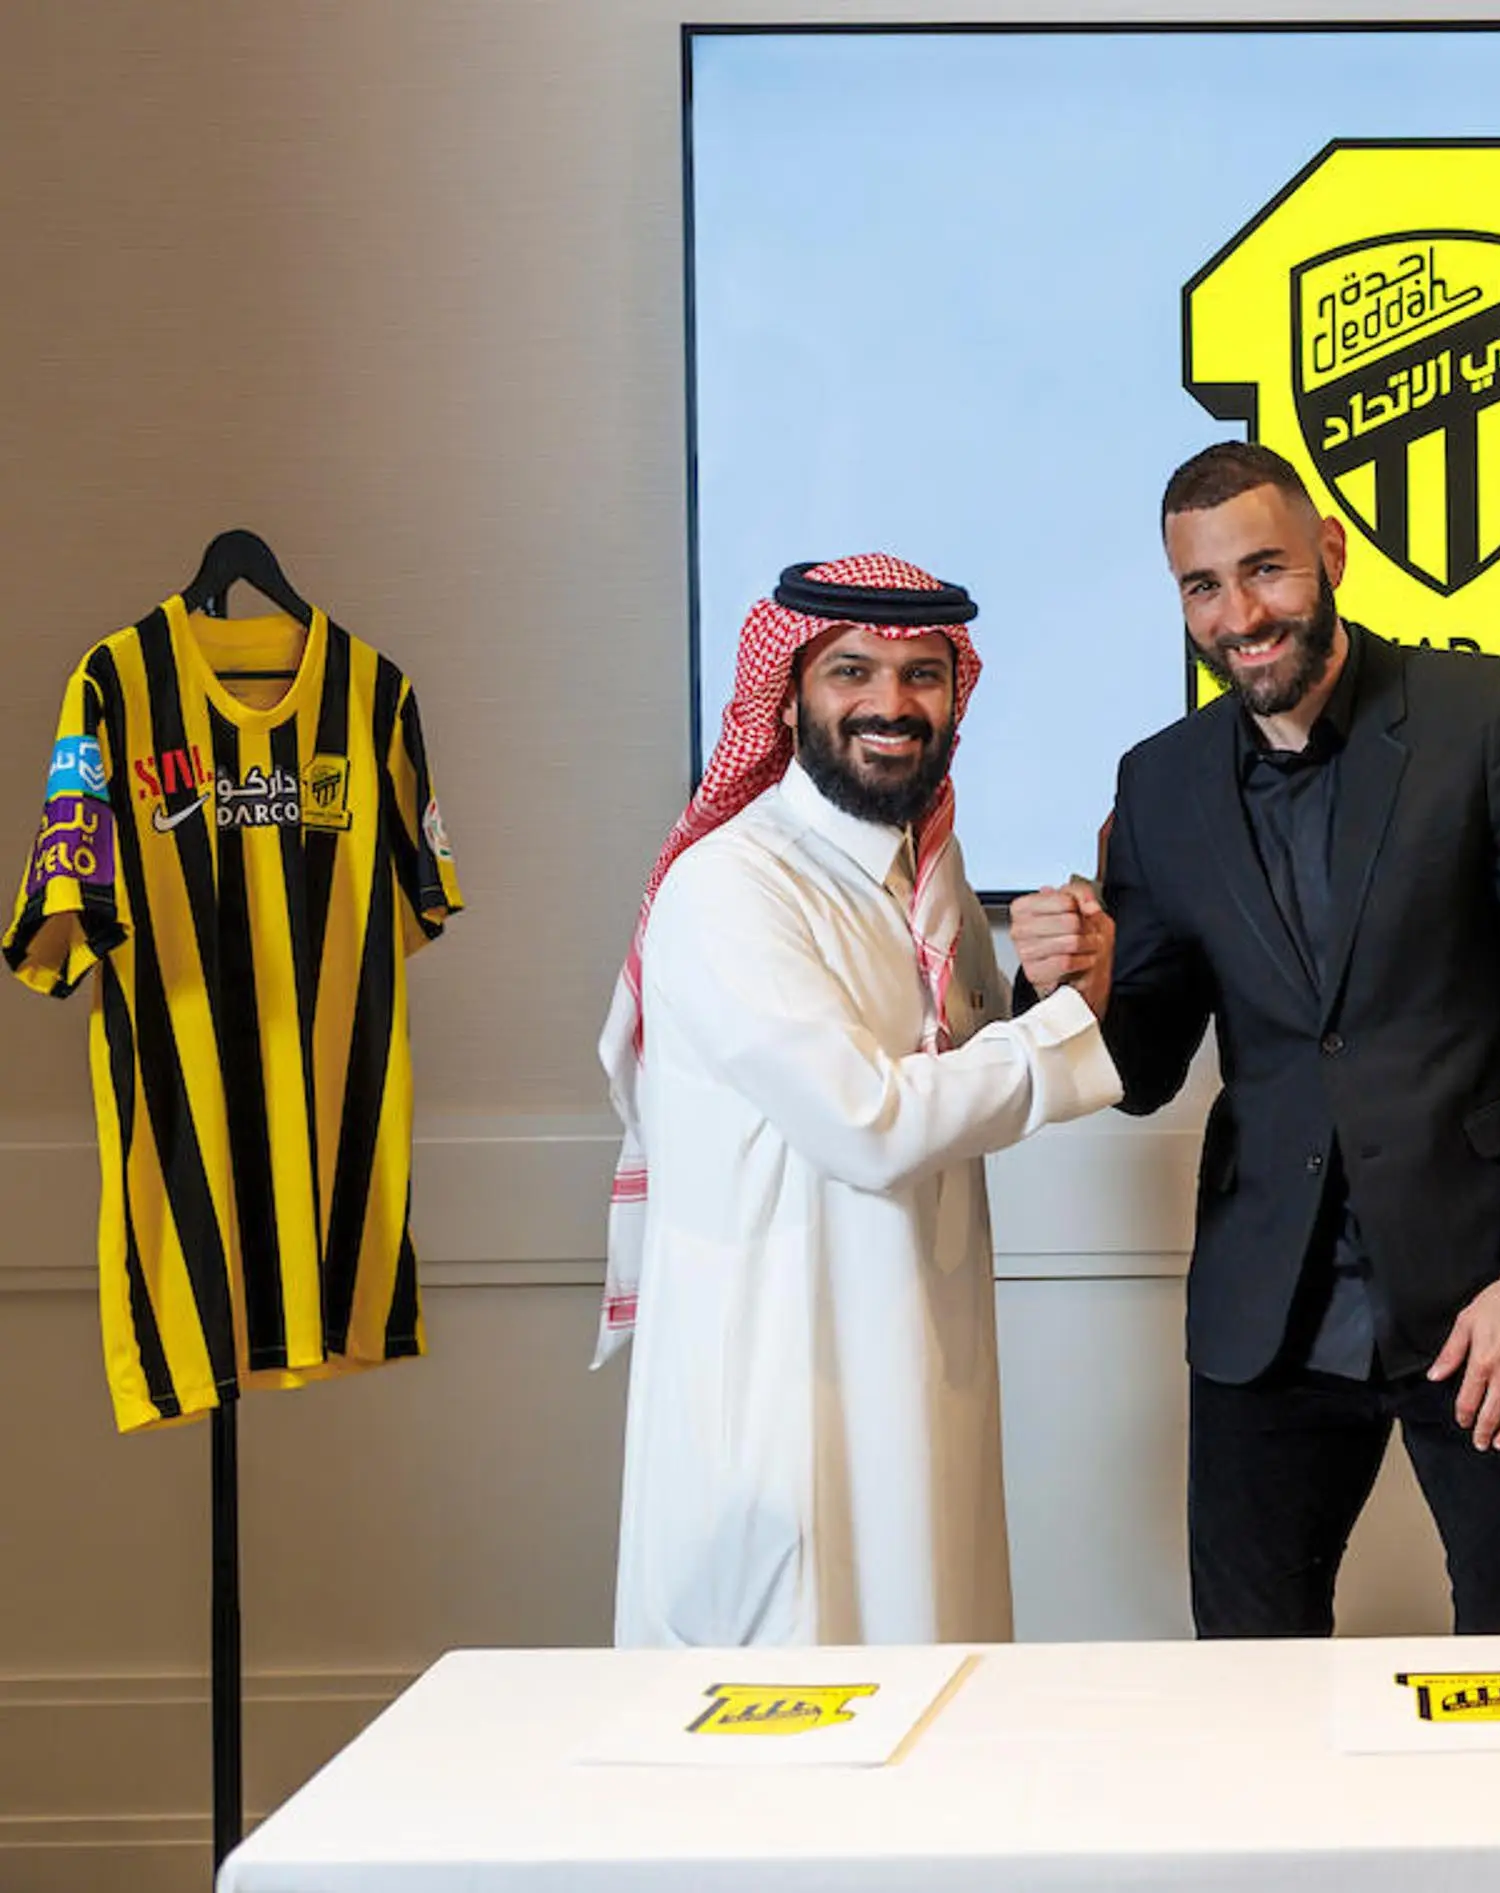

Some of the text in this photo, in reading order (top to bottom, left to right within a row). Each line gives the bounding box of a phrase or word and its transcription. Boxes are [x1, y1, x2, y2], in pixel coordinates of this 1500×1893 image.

[1321, 348, 1452, 452] الاتحاد
[216, 765, 299, 801] داركو
[216, 801, 300, 827] DARCO
